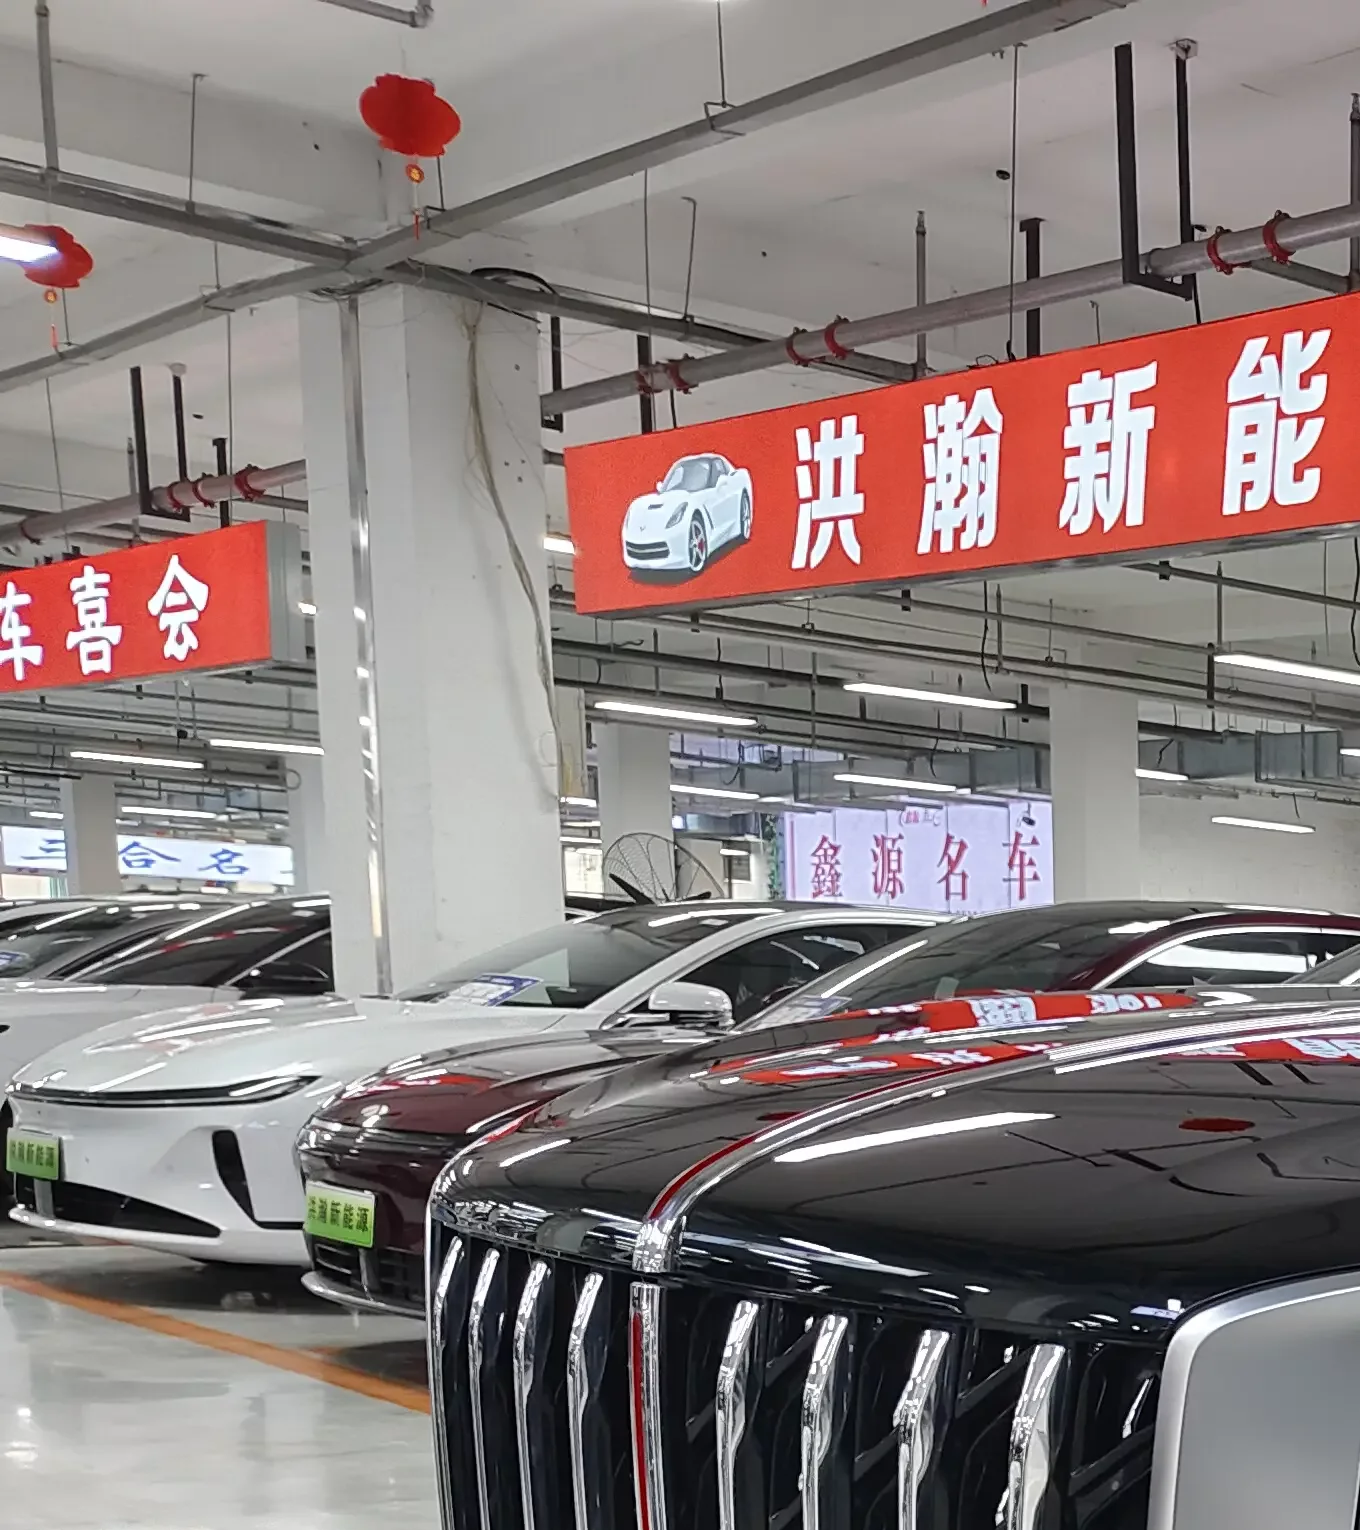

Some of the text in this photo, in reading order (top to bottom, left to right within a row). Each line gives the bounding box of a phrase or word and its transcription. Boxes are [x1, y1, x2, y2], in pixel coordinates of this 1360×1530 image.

[0, 554, 209, 682] 车喜会
[811, 832, 1041, 901] 鑫源名车
